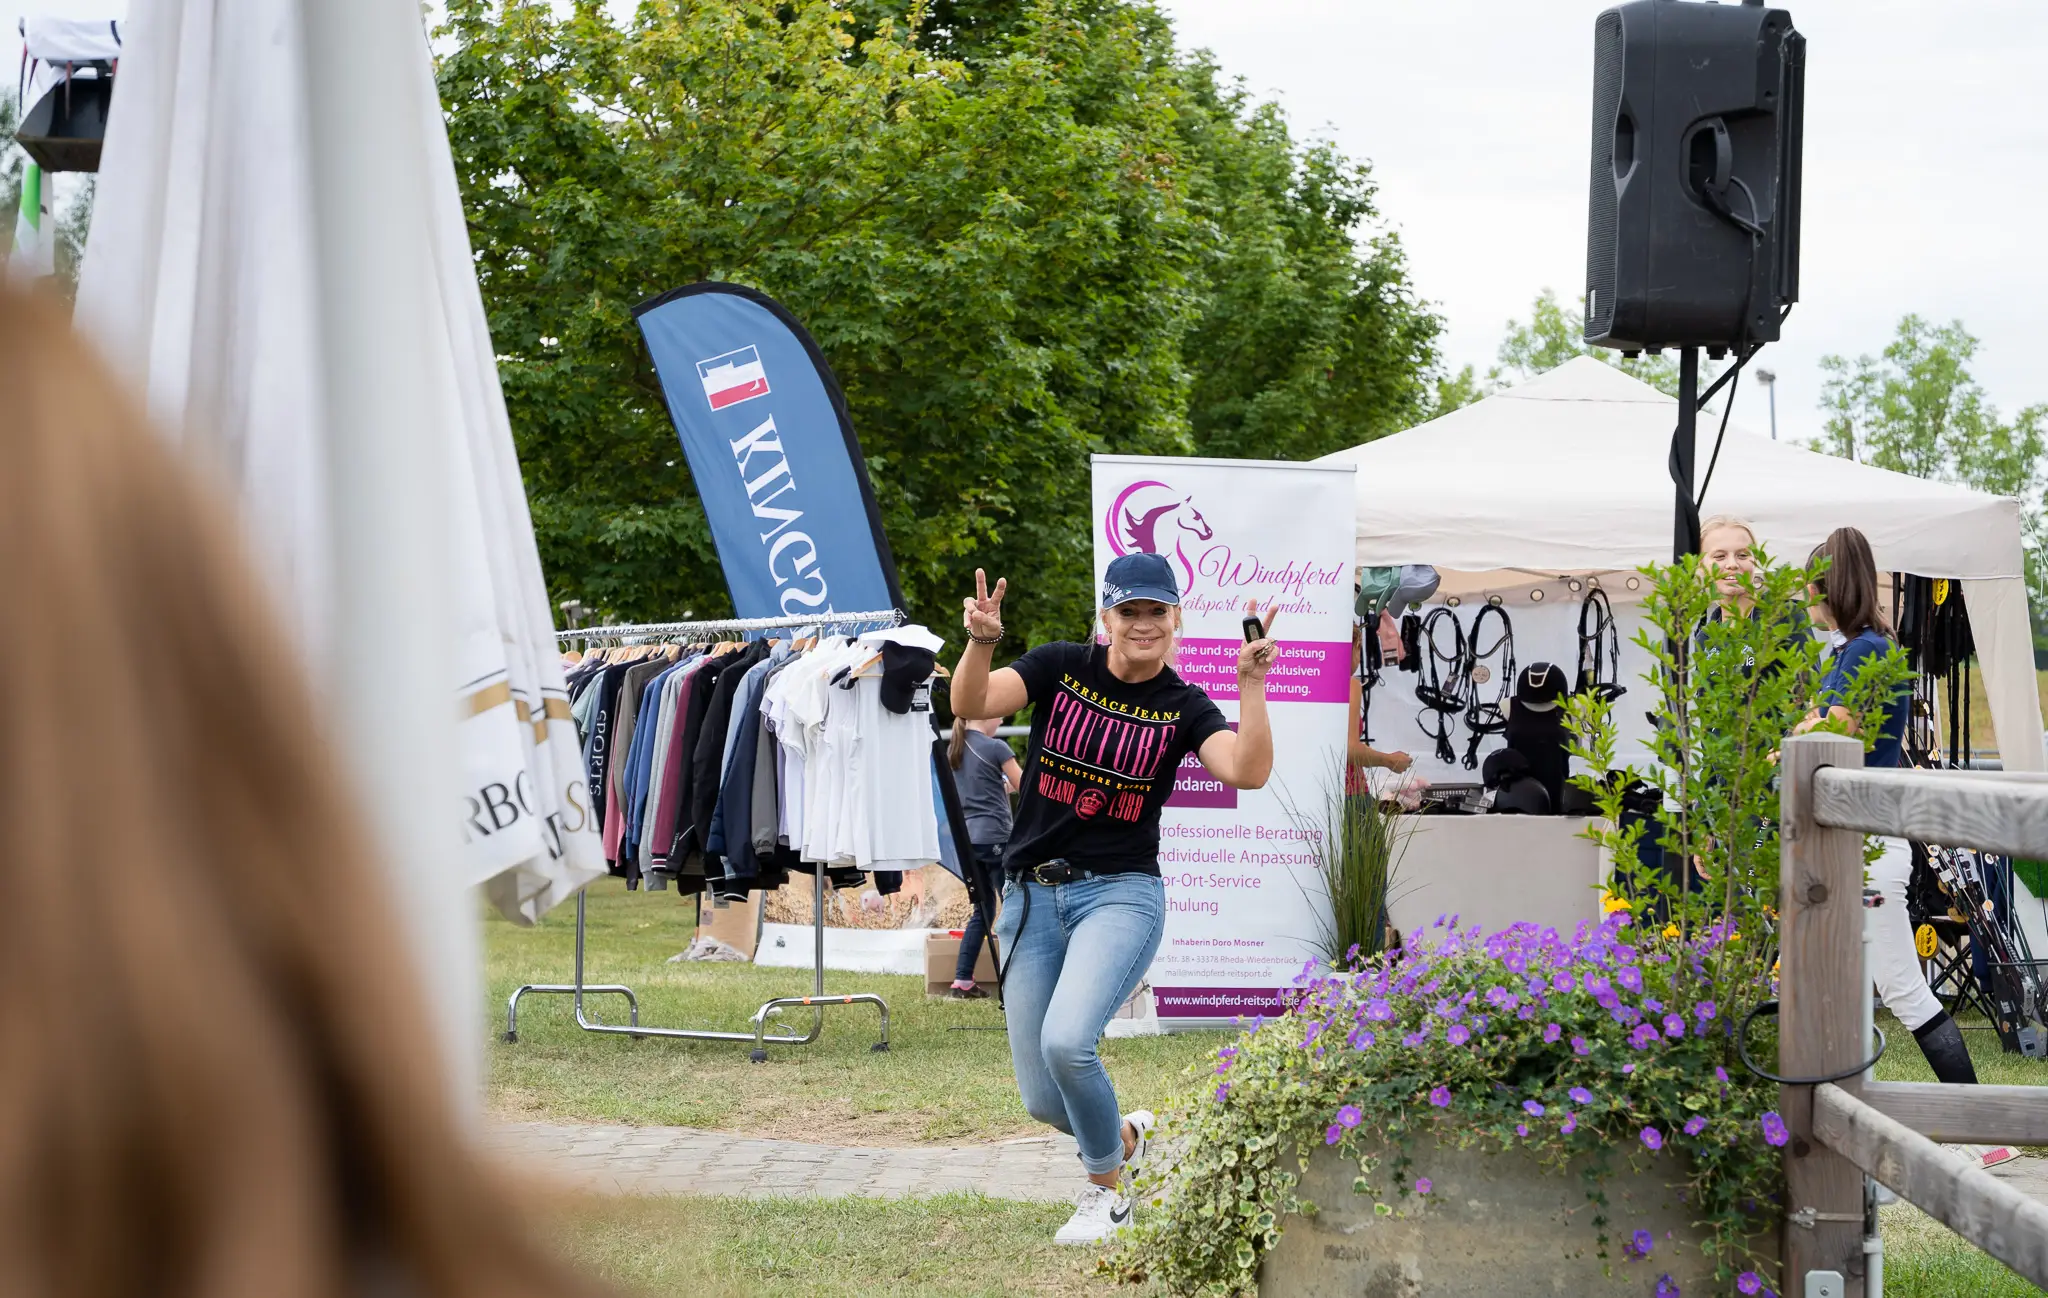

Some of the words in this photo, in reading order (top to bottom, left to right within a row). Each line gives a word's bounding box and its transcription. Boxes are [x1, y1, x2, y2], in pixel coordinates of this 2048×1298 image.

[1199, 545, 1344, 596] Windpferd
[1183, 594, 1240, 617] eitsport
[1176, 645, 1197, 655] onie
[1198, 645, 1221, 656] und
[1223, 647, 1241, 658] spo
[1280, 647, 1325, 661] Leistung
[1185, 662, 1215, 673] durch
[1218, 665, 1238, 674] uns
[1063, 673, 1127, 713] VERSACE
[1212, 683, 1240, 692] unse
[1264, 682, 1311, 696] fahrung.
[1044, 691, 1176, 777] COUTURE
[1040, 756, 1054, 767] BIG
[1060, 764, 1111, 786] COUTURE
[1173, 776, 1223, 792] ndaren
[1038, 772, 1076, 805] MILANO
[1107, 790, 1144, 823] 1988
[1159, 824, 1251, 839] rofessionelle
[1256, 826, 1323, 842] Beratung
[1157, 848, 1236, 863] ndividuelle
[1240, 850, 1321, 868] Anpassung
[1162, 873, 1262, 888] or-Ort-Service
[1164, 897, 1219, 916] hulung
[1172, 938, 1211, 947] Inhaberin
[1213, 939, 1232, 947] Doro
[1233, 939, 1264, 947] Mosner
[1167, 955, 1180, 963] Str.
[1164, 994, 1300, 1008] www.windpferd-reitspotde
